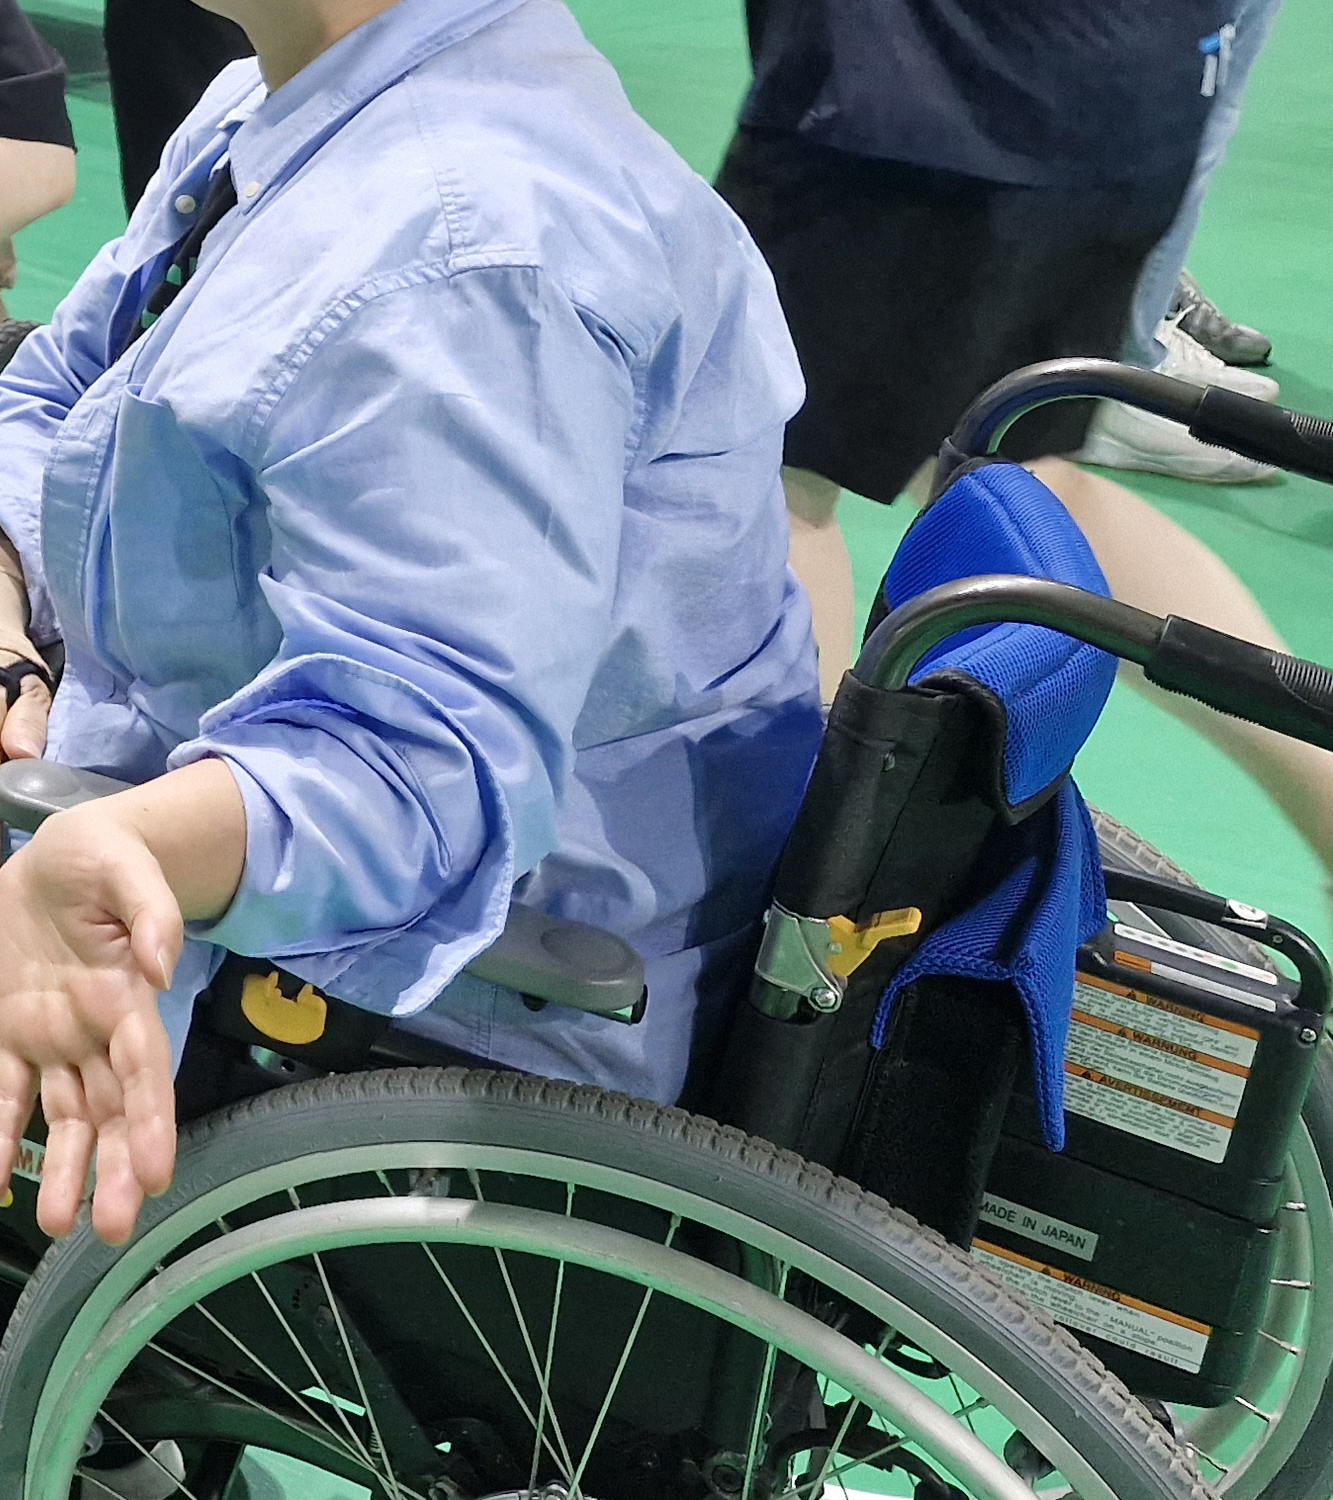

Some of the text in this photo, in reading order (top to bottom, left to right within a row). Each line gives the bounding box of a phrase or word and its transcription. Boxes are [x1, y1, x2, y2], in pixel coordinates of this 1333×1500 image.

[1145, 993, 1206, 1023] WARNING
[1132, 1031, 1198, 1061] WARNUNG
[978, 1201, 1087, 1250] MADE IN JAPAN
[1063, 1272, 1122, 1302] WARNING
